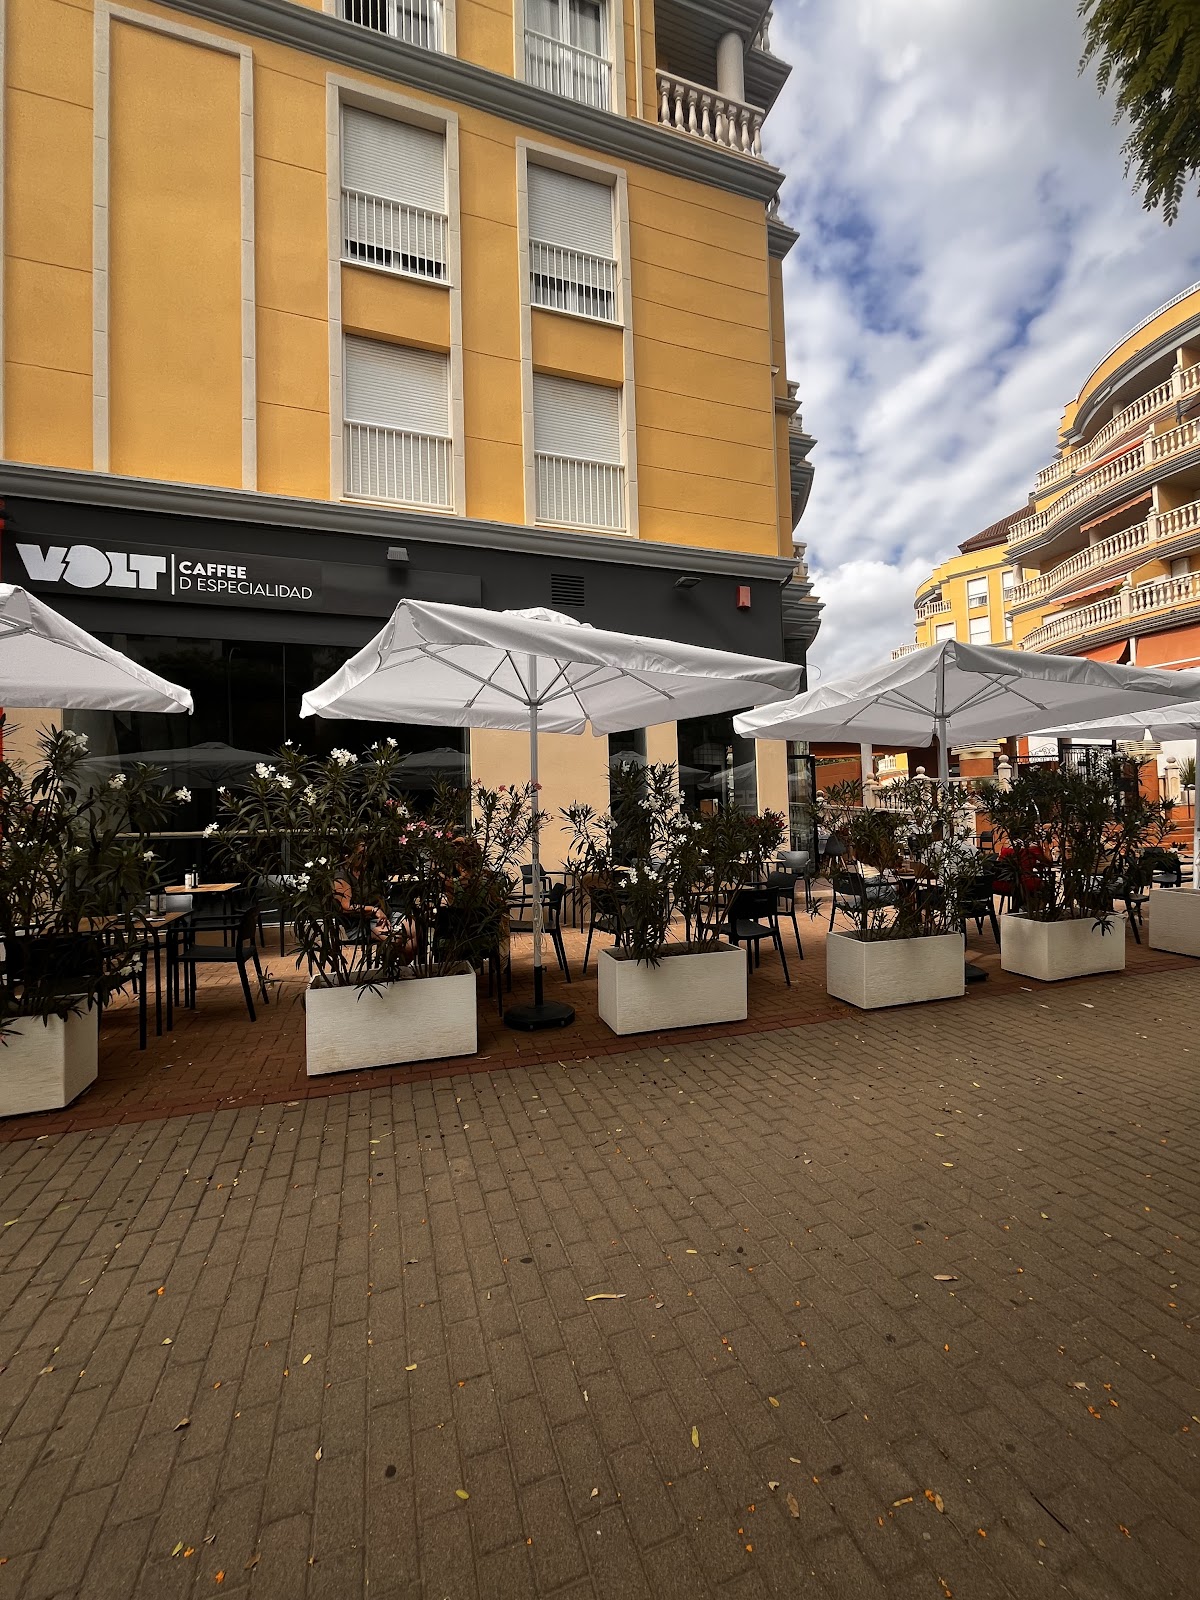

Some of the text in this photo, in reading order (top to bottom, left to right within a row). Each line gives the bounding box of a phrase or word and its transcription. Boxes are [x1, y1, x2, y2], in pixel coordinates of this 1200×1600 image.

[15, 543, 167, 590] VOLT
[178, 561, 247, 580] CAFFEE
[197, 577, 313, 600] ESPECIALIDAD
